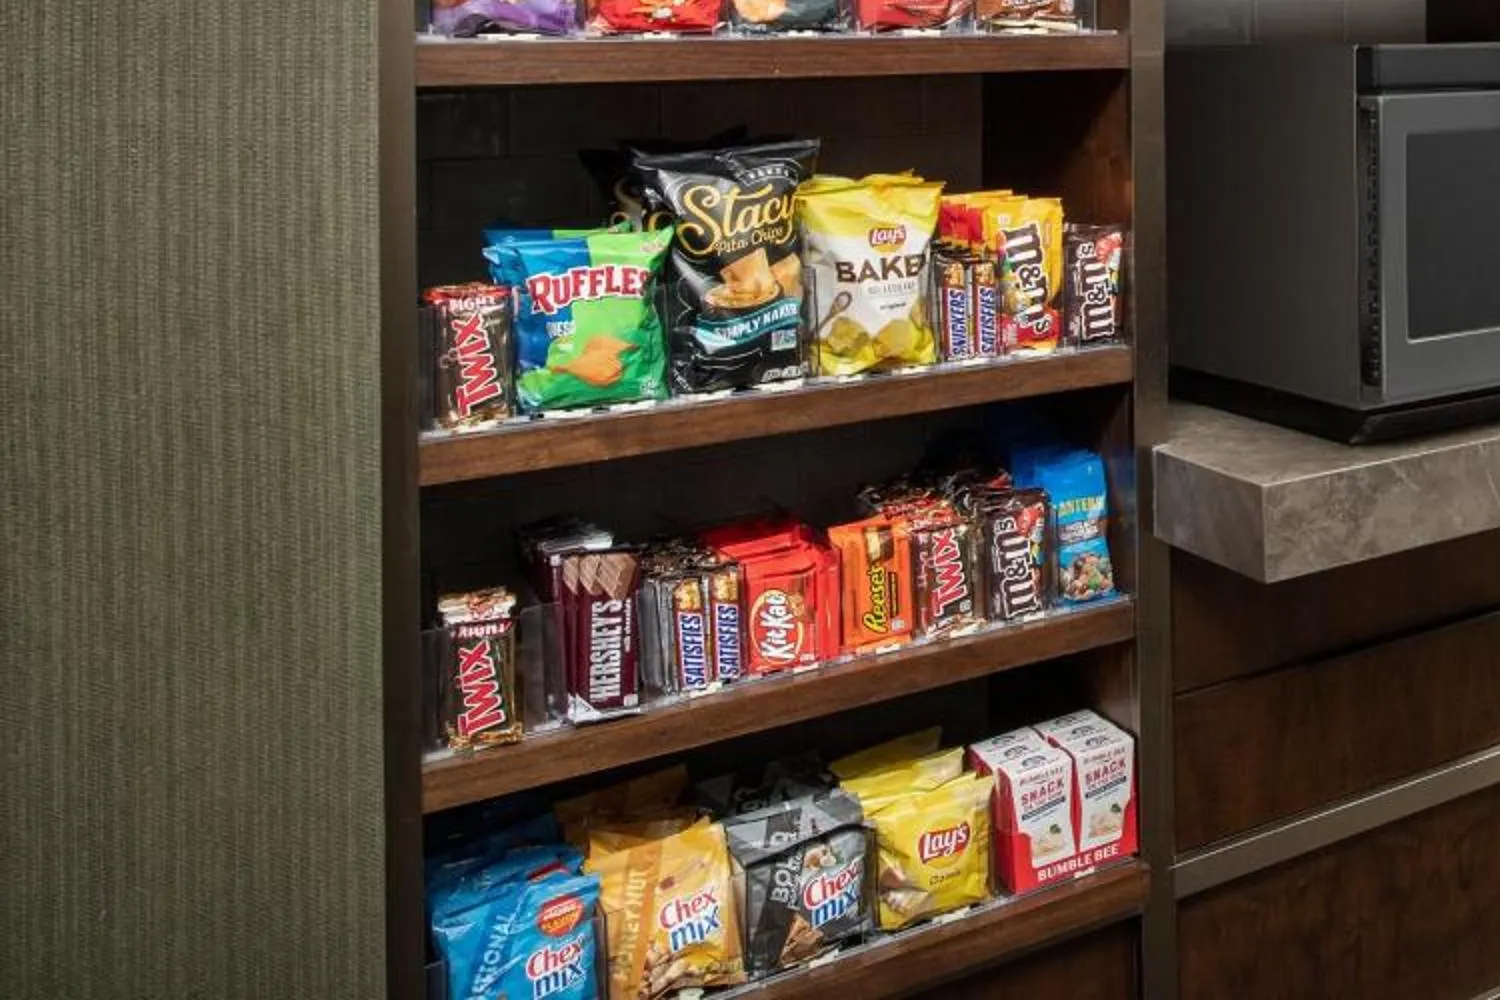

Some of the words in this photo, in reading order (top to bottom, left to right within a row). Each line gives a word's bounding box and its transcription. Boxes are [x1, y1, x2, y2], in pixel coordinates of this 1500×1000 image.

[675, 183, 799, 255] Stacy
[526, 264, 651, 315] RUFFLES
[452, 313, 502, 418] TWIX
[931, 530, 968, 617] TWIX
[589, 598, 623, 703] HERSHEY'S
[680, 613, 707, 689] SATISFIES
[716, 604, 741, 681] SATISFIES
[457, 639, 505, 737] TWIX
[919, 822, 970, 864] Lay's
[1037, 853, 1094, 882] BUMBLE
[1094, 844, 1120, 862] BEE
[770, 854, 798, 904] BOL
[803, 862, 863, 910] Chex
[658, 887, 717, 930] Chex
[668, 904, 721, 953] mix
[810, 885, 858, 928] mix
[526, 942, 583, 979] Chex
[533, 961, 587, 1000] mix
